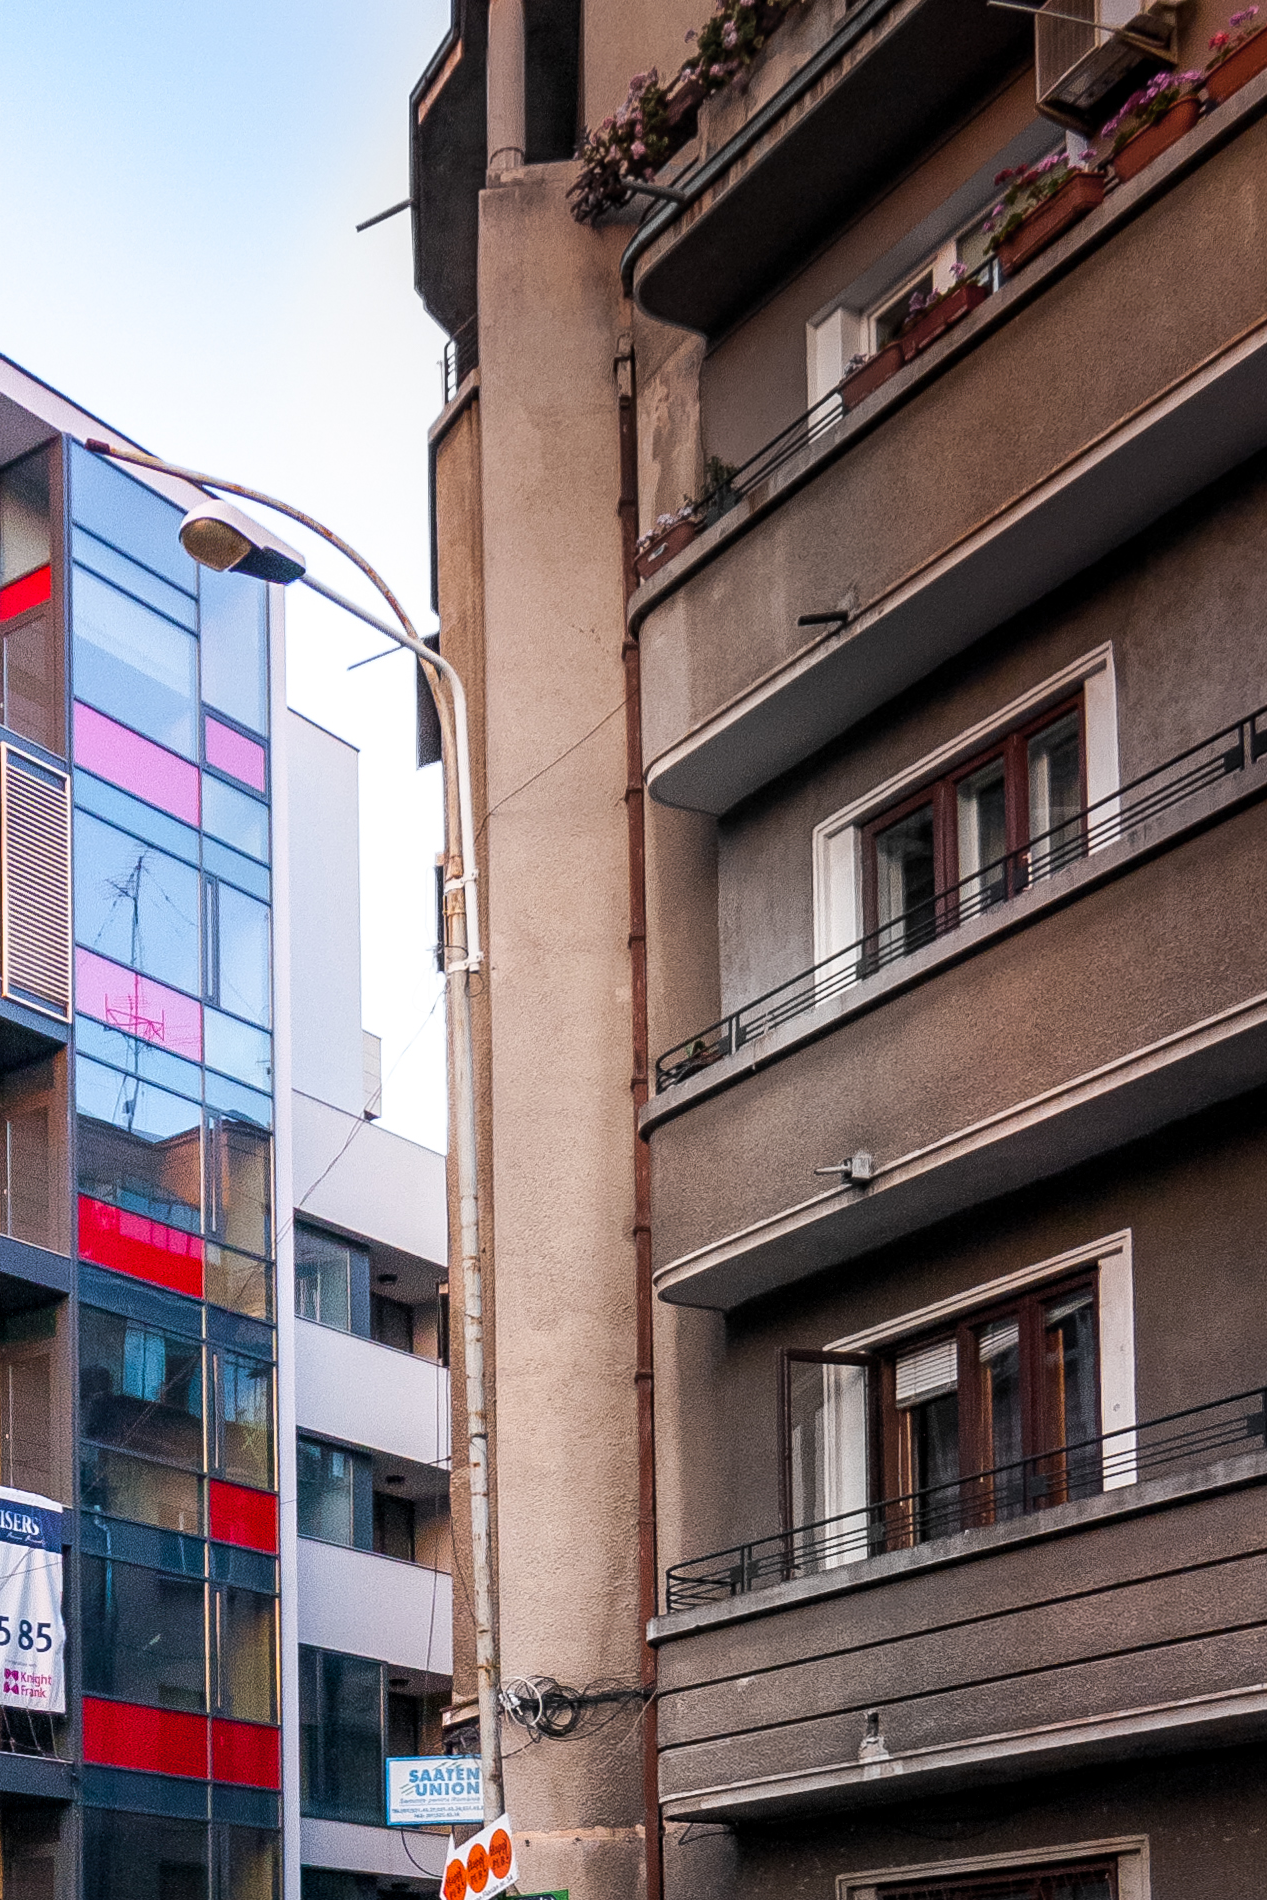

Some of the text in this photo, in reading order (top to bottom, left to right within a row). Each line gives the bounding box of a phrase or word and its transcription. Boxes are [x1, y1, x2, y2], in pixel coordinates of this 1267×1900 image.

[21, 1672, 52, 1687] Knight
[21, 1685, 46, 1698] Frank
[409, 1767, 480, 1783] SAATEN
[415, 1782, 480, 1796] UNION
